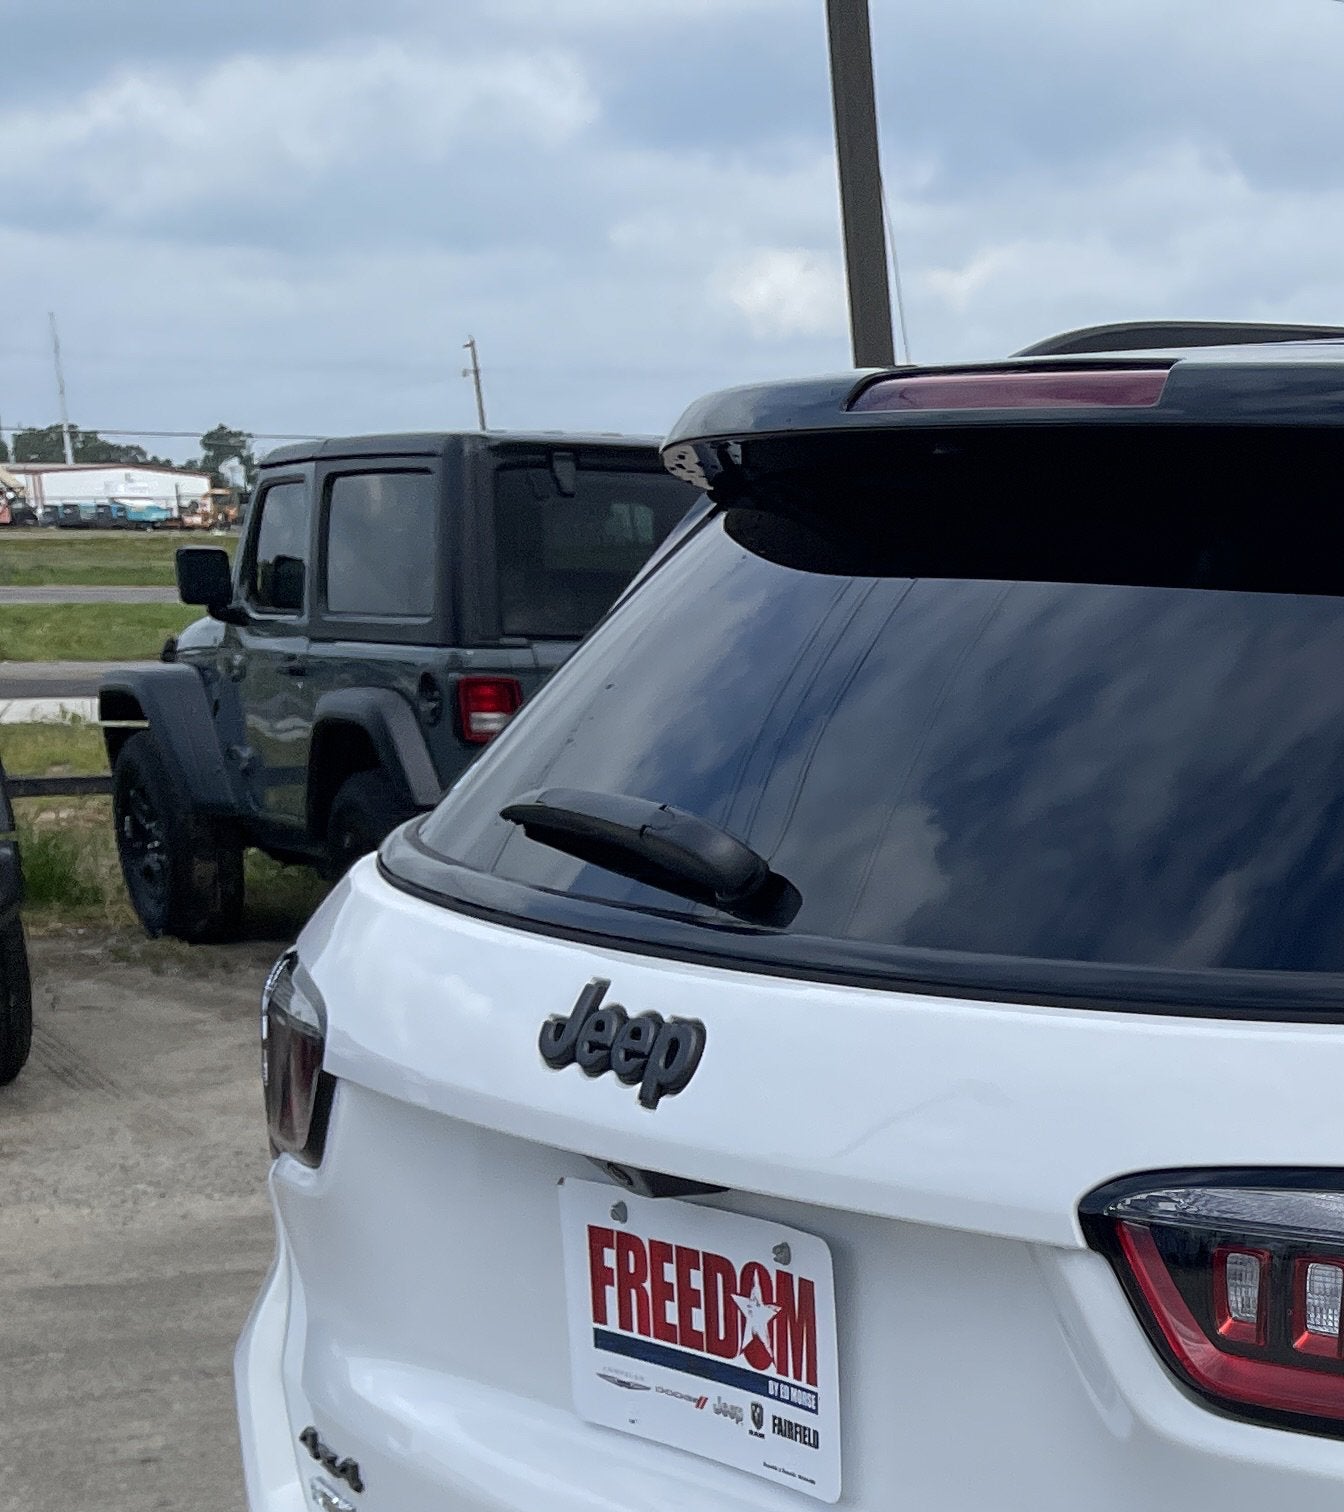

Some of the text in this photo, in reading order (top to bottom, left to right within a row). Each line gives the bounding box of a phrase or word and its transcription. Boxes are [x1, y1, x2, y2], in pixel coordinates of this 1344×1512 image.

[538, 977, 707, 1111] Jeep
[587, 1224, 818, 1387] FREEDOM
[772, 1415, 819, 1449] FAIRFIELD
